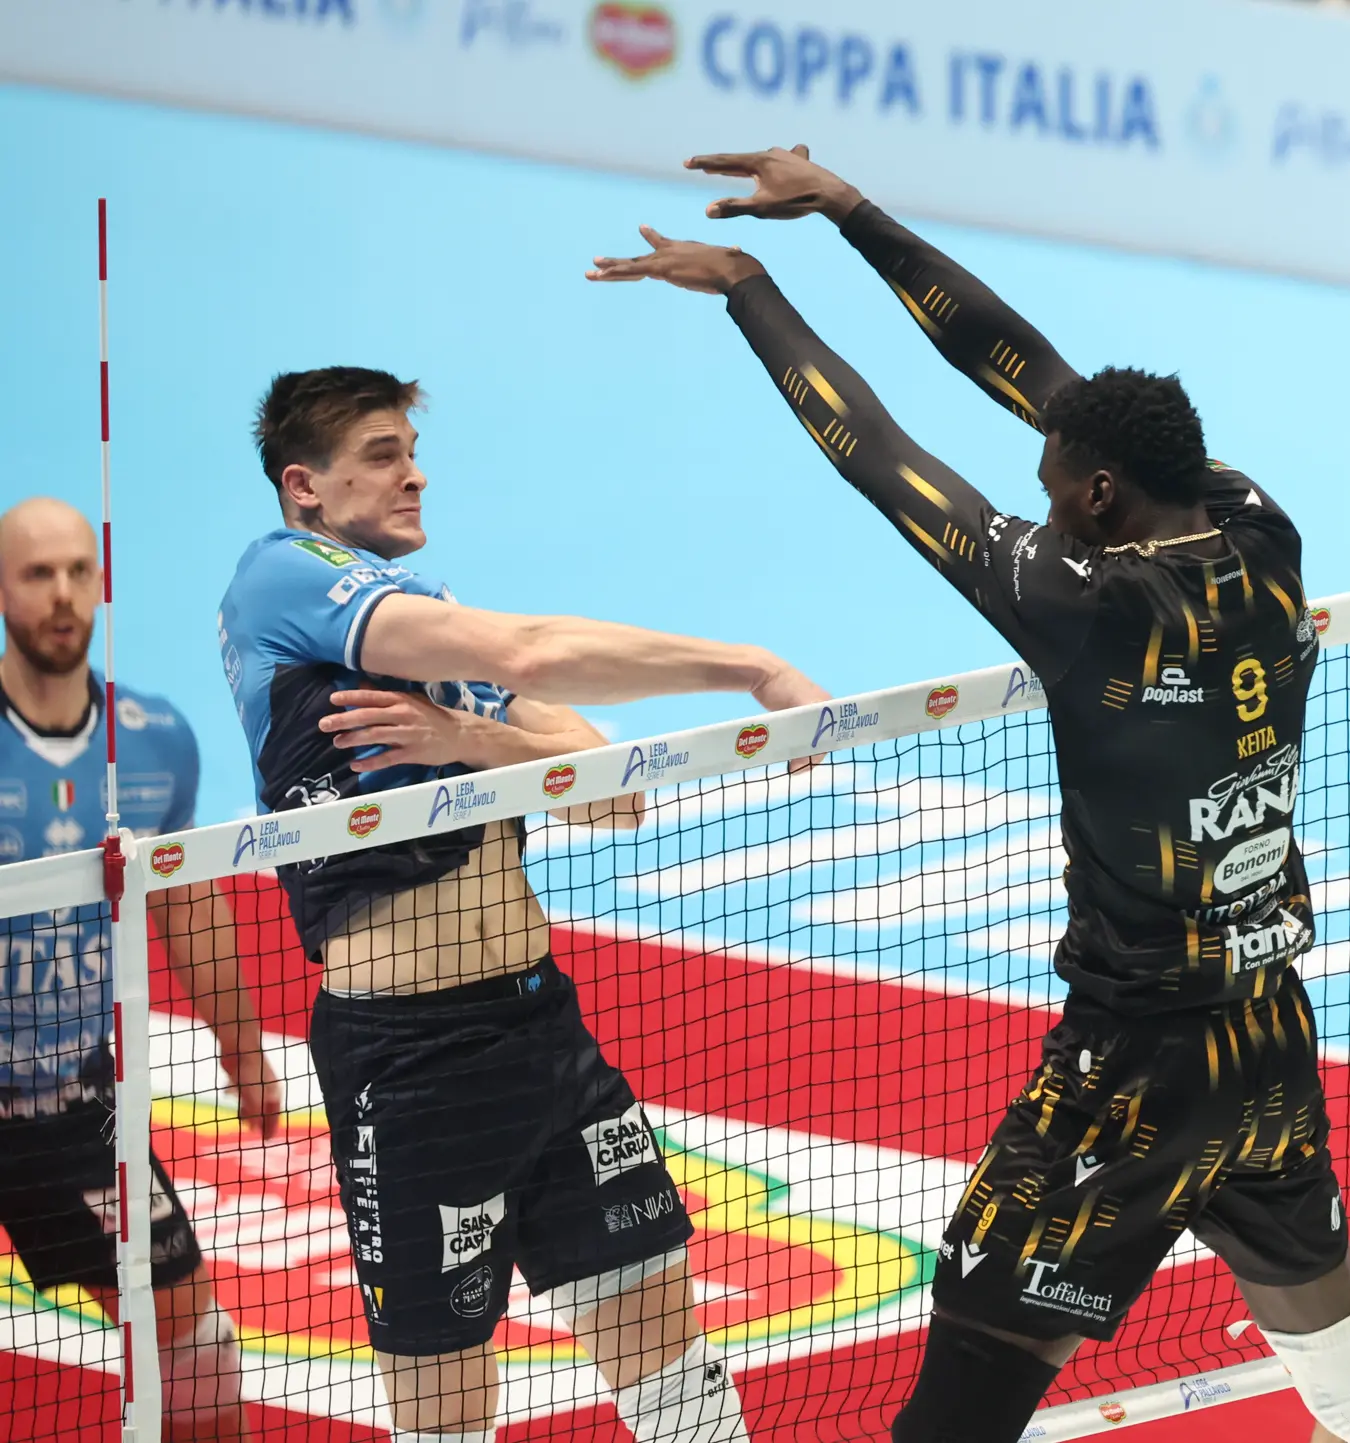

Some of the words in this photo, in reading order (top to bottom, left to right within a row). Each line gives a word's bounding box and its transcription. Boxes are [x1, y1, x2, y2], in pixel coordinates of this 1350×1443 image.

[701, 16, 919, 116] COPPA
[948, 49, 1163, 150] ITALIA
[1141, 686, 1204, 706] poplast
[1231, 658, 1269, 722] 9
[839, 702, 858, 717] LEGA
[928, 698, 940, 708] Del
[939, 694, 957, 706] Monte
[838, 712, 879, 732] PALLAVOLO
[649, 741, 668, 756] LEGA
[738, 737, 750, 747] Del
[748, 732, 768, 745] Monte
[1236, 725, 1277, 760] KEITA
[648, 751, 689, 771] PALLAVOLO
[456, 781, 475, 796] LEGA
[546, 777, 557, 787] Del
[556, 772, 575, 784] Monte
[454, 790, 496, 811] PALLAVOLO
[260, 821, 279, 835] LEGA
[350, 817, 361, 827] Del
[361, 813, 380, 824] Monte
[259, 829, 301, 850] PALLAVOLO
[1243, 838, 1271, 855] FORNO
[152, 854, 163, 865] Del
[163, 851, 183, 863] Monte
[1222, 840, 1286, 881] Bonomi
[602, 1120, 641, 1146] SAN
[598, 1135, 650, 1166] CARLO
[460, 1213, 494, 1235] SAN
[977, 1202, 998, 1232] 9
[1022, 1256, 1113, 1312] Toffaletti
